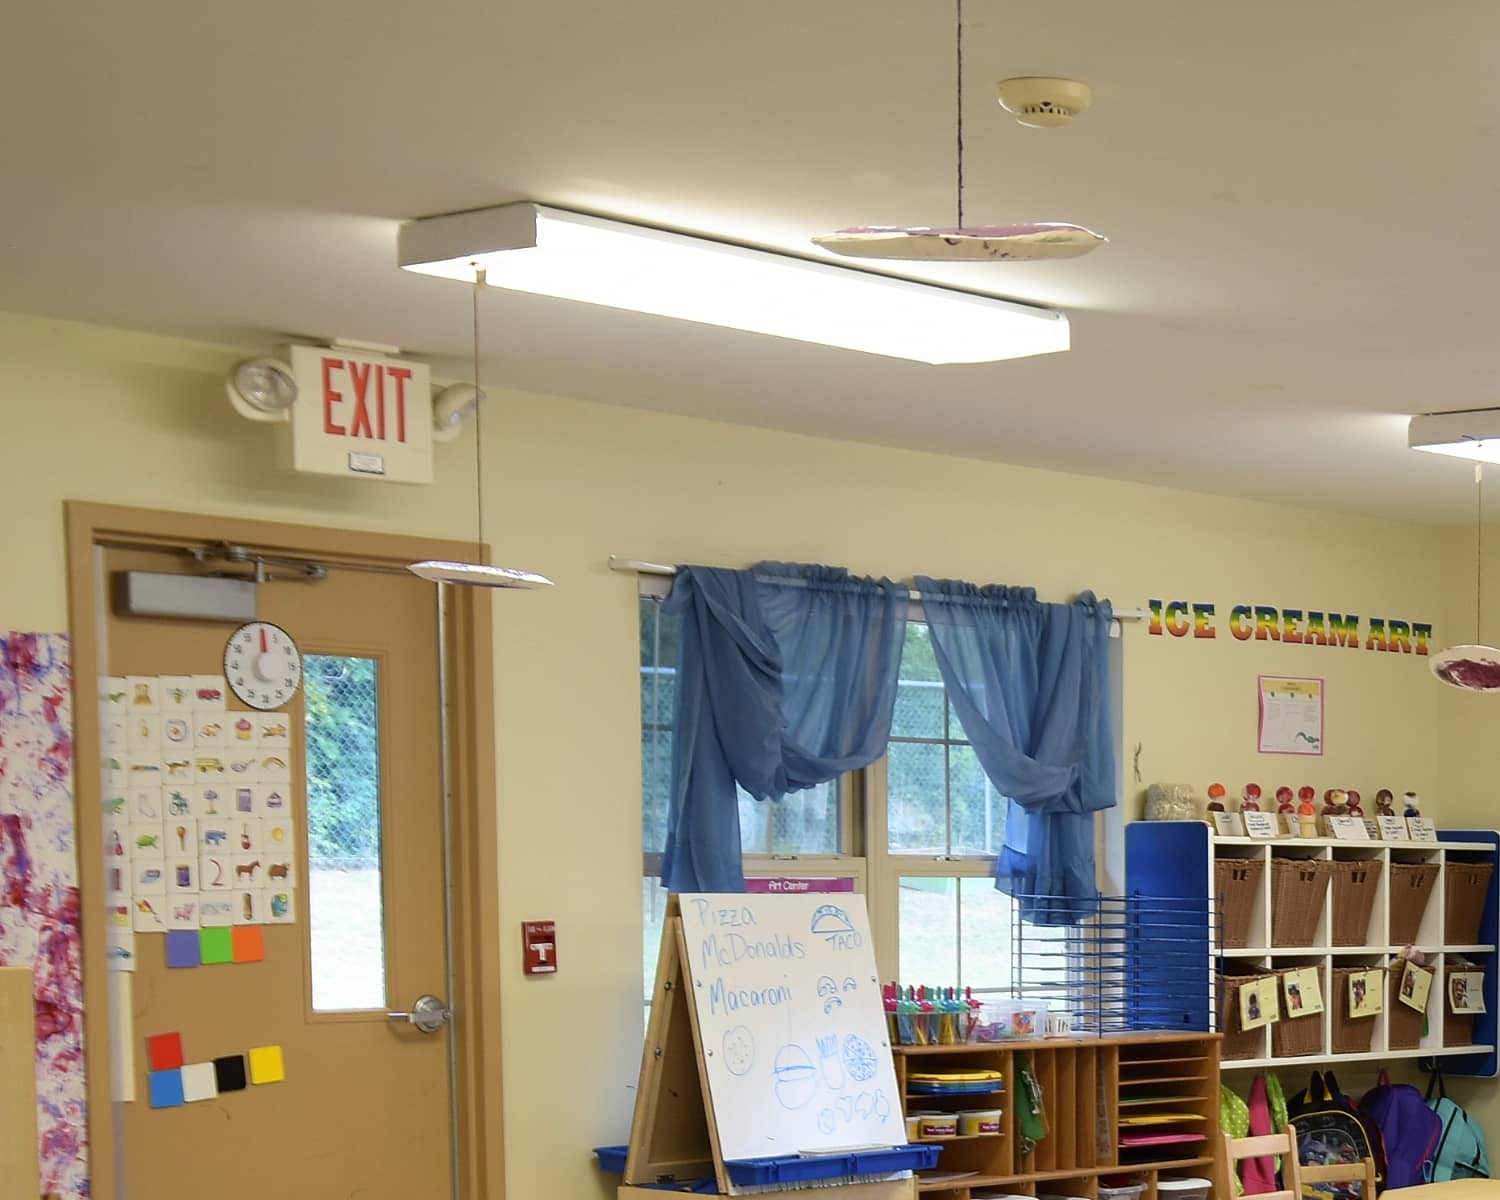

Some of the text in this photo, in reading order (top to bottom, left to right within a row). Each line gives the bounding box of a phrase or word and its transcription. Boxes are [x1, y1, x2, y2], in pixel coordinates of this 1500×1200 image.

[321, 357, 413, 443] EXIT
[1148, 599, 1433, 656] ICE CREAM ART
[769, 880, 809, 890] Art Center
[690, 898, 757, 927] Pizza
[701, 932, 807, 969] McDonalds
[825, 931, 863, 950] TACO
[709, 976, 793, 1016] Macaroni
